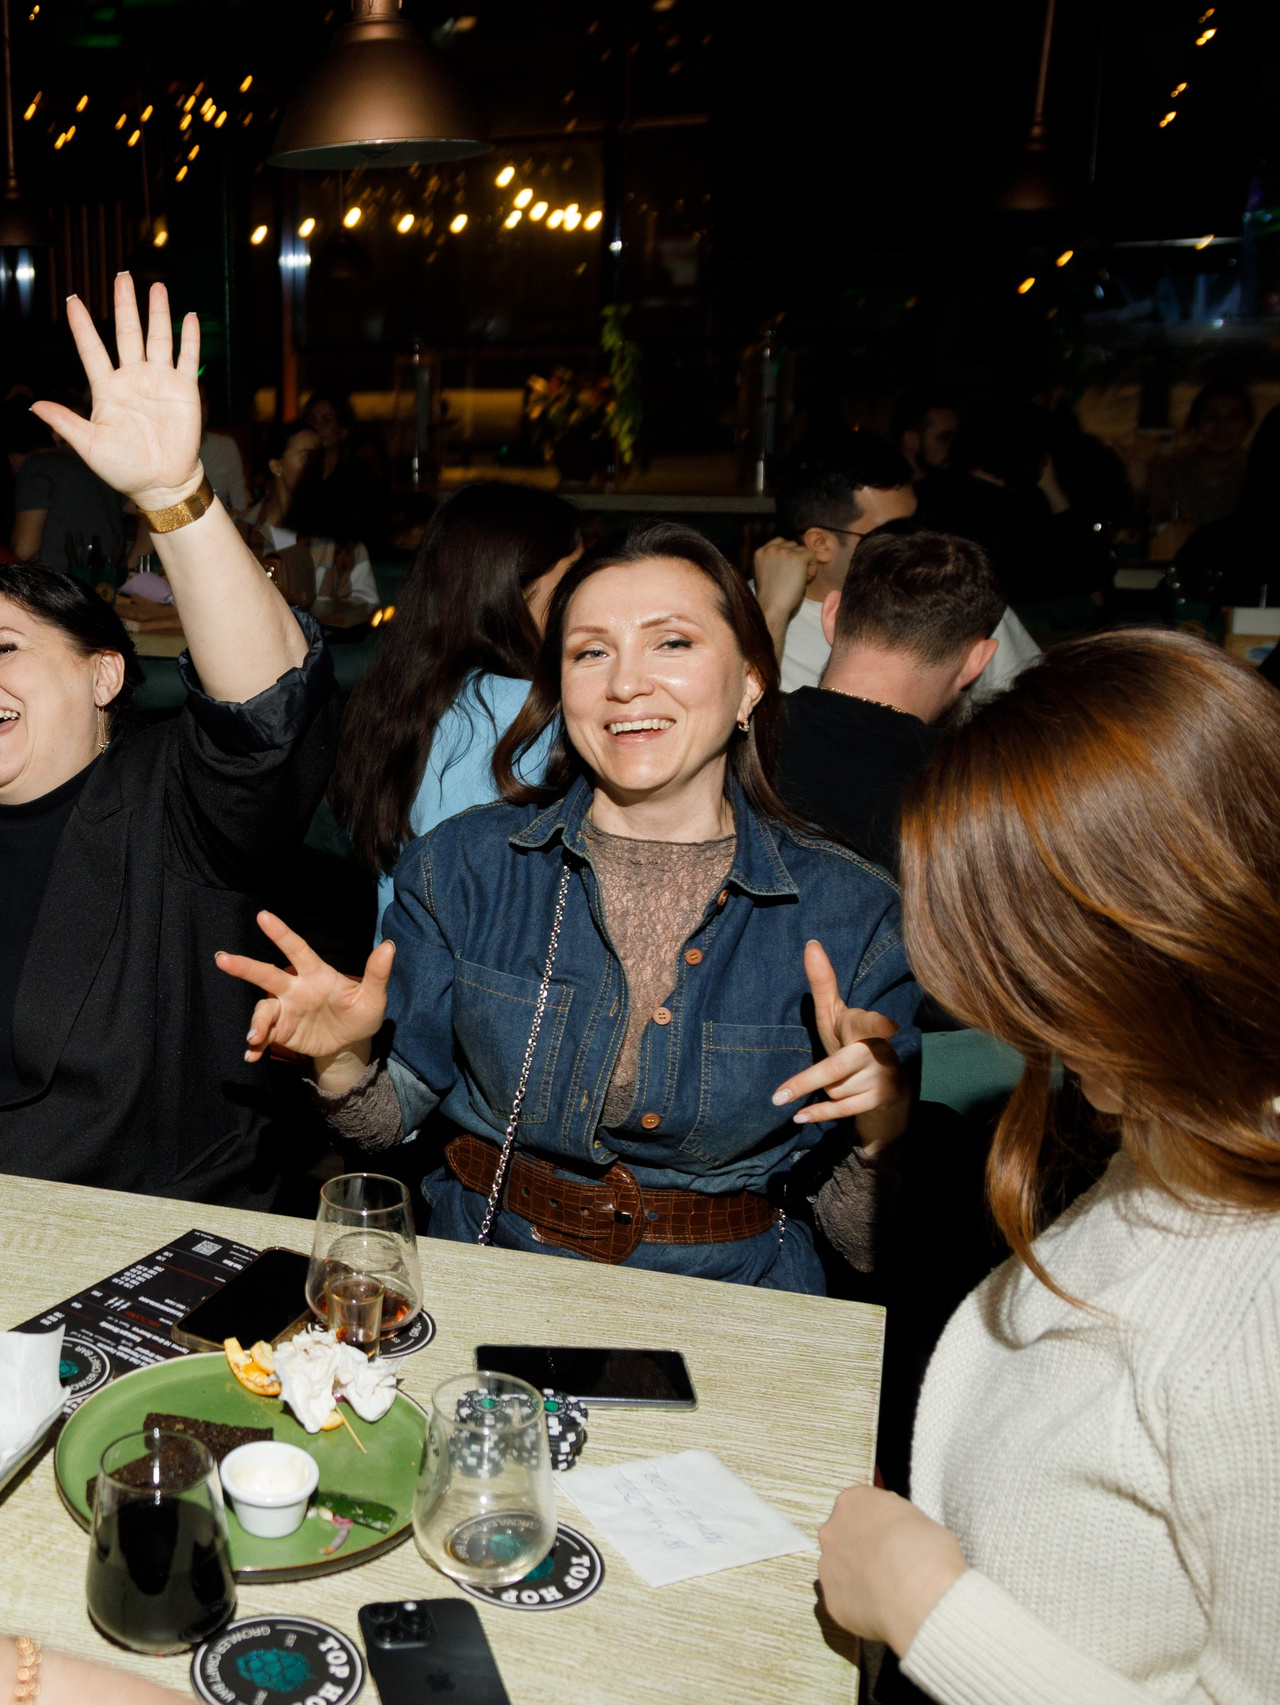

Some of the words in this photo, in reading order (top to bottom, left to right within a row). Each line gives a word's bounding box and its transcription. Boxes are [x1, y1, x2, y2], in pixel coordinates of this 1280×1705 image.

[563, 1554, 591, 1590] TOP
[500, 1585, 564, 1604] HOP
[215, 1624, 271, 1655] GROWLER
[318, 1636, 350, 1679] TOP
[292, 1681, 345, 1705] HO
